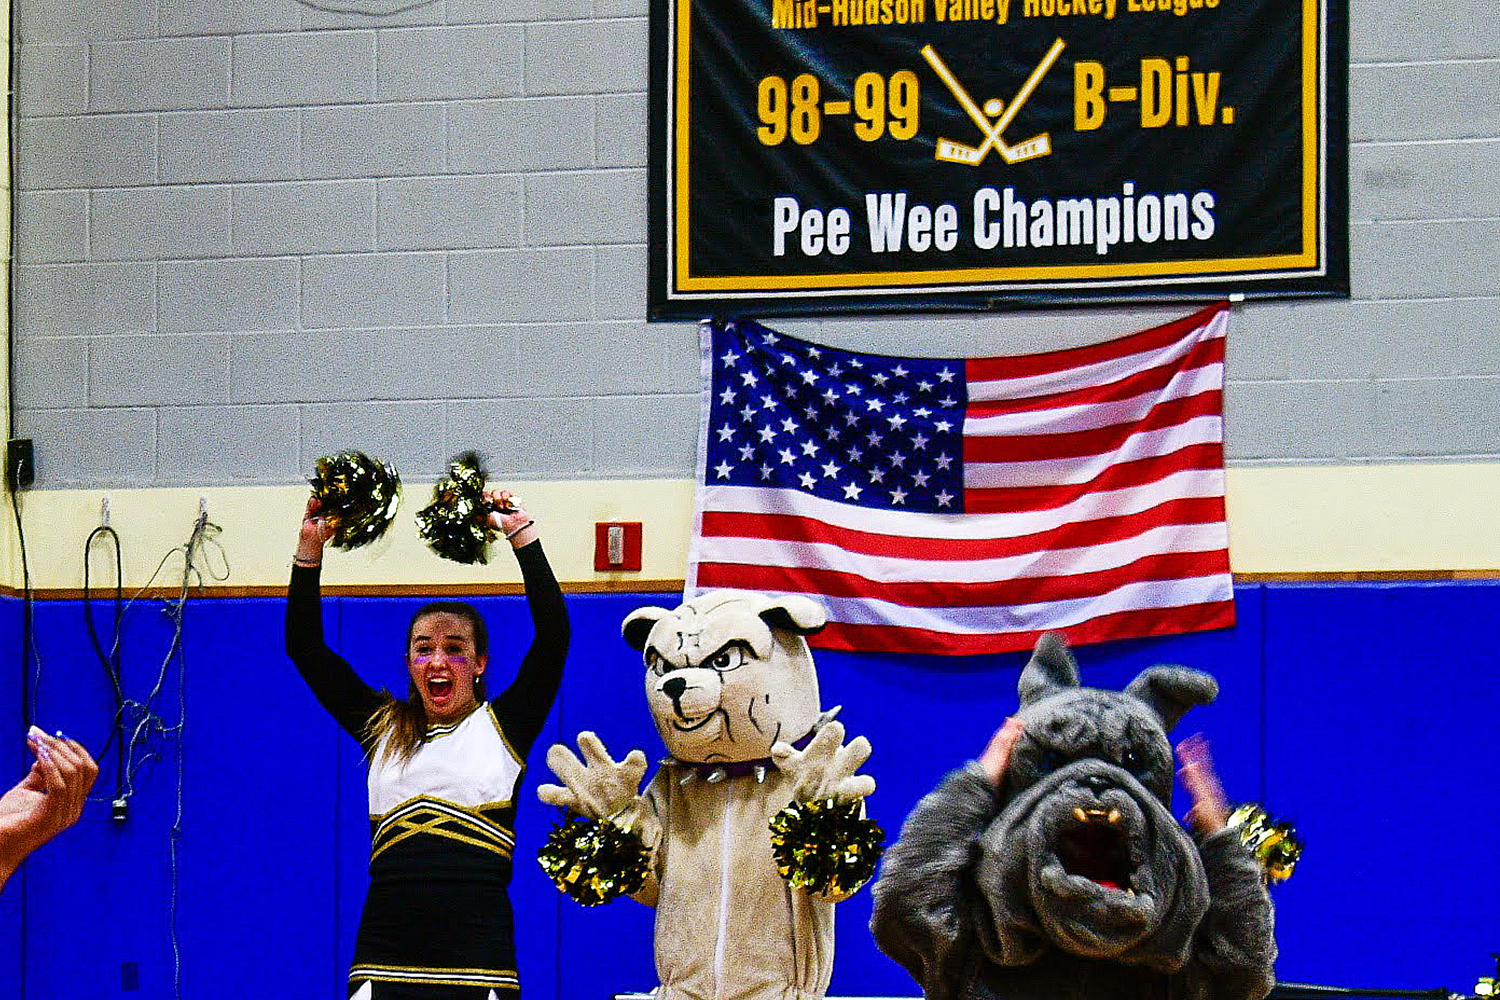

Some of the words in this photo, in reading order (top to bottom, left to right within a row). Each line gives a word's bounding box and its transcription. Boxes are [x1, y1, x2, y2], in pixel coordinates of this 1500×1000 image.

[771, 0, 926, 30] Mid-Hudson
[933, 0, 1010, 25] Valley
[756, 70, 920, 146] 98-99
[1073, 56, 1235, 132] B-Div.
[773, 197, 851, 258] Pee
[865, 192, 960, 255] Wee
[973, 181, 1216, 256] Champions
